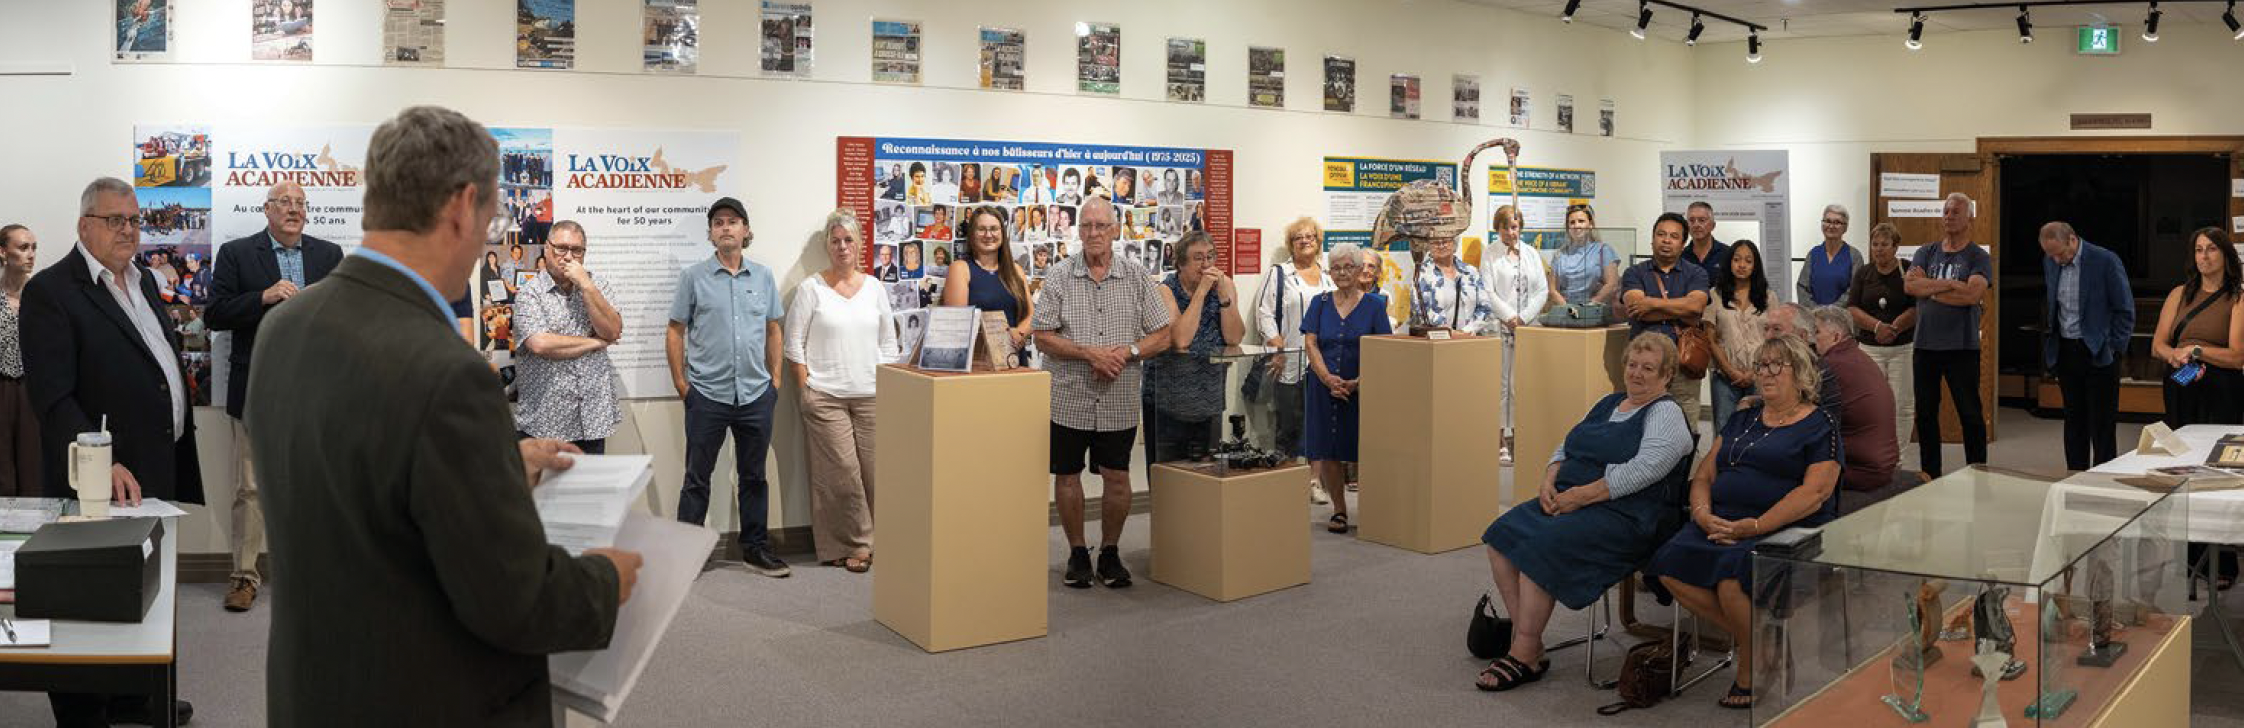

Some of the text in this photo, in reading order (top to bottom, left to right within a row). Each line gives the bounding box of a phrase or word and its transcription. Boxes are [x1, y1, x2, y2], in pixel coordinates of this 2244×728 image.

[882, 141, 970, 156] Reconnaissance
[972, 145, 980, 157] à
[982, 147, 999, 157] nos
[1002, 146, 1053, 159] bâtisseurs
[1055, 148, 1081, 159] d'hier
[1084, 149, 1090, 160] à
[1092, 149, 1144, 163] aujourd'hui
[566, 173, 687, 189] ACADIENNE
[1667, 178, 1752, 190] ACADIENNE
[234, 204, 247, 213] Au
[576, 205, 586, 214] At
[588, 205, 604, 214] the
[606, 205, 631, 214] heart
[633, 205, 643, 214] of
[644, 206, 660, 214] our
[314, 216, 327, 224] 50
[617, 216, 672, 226] for 50 years
